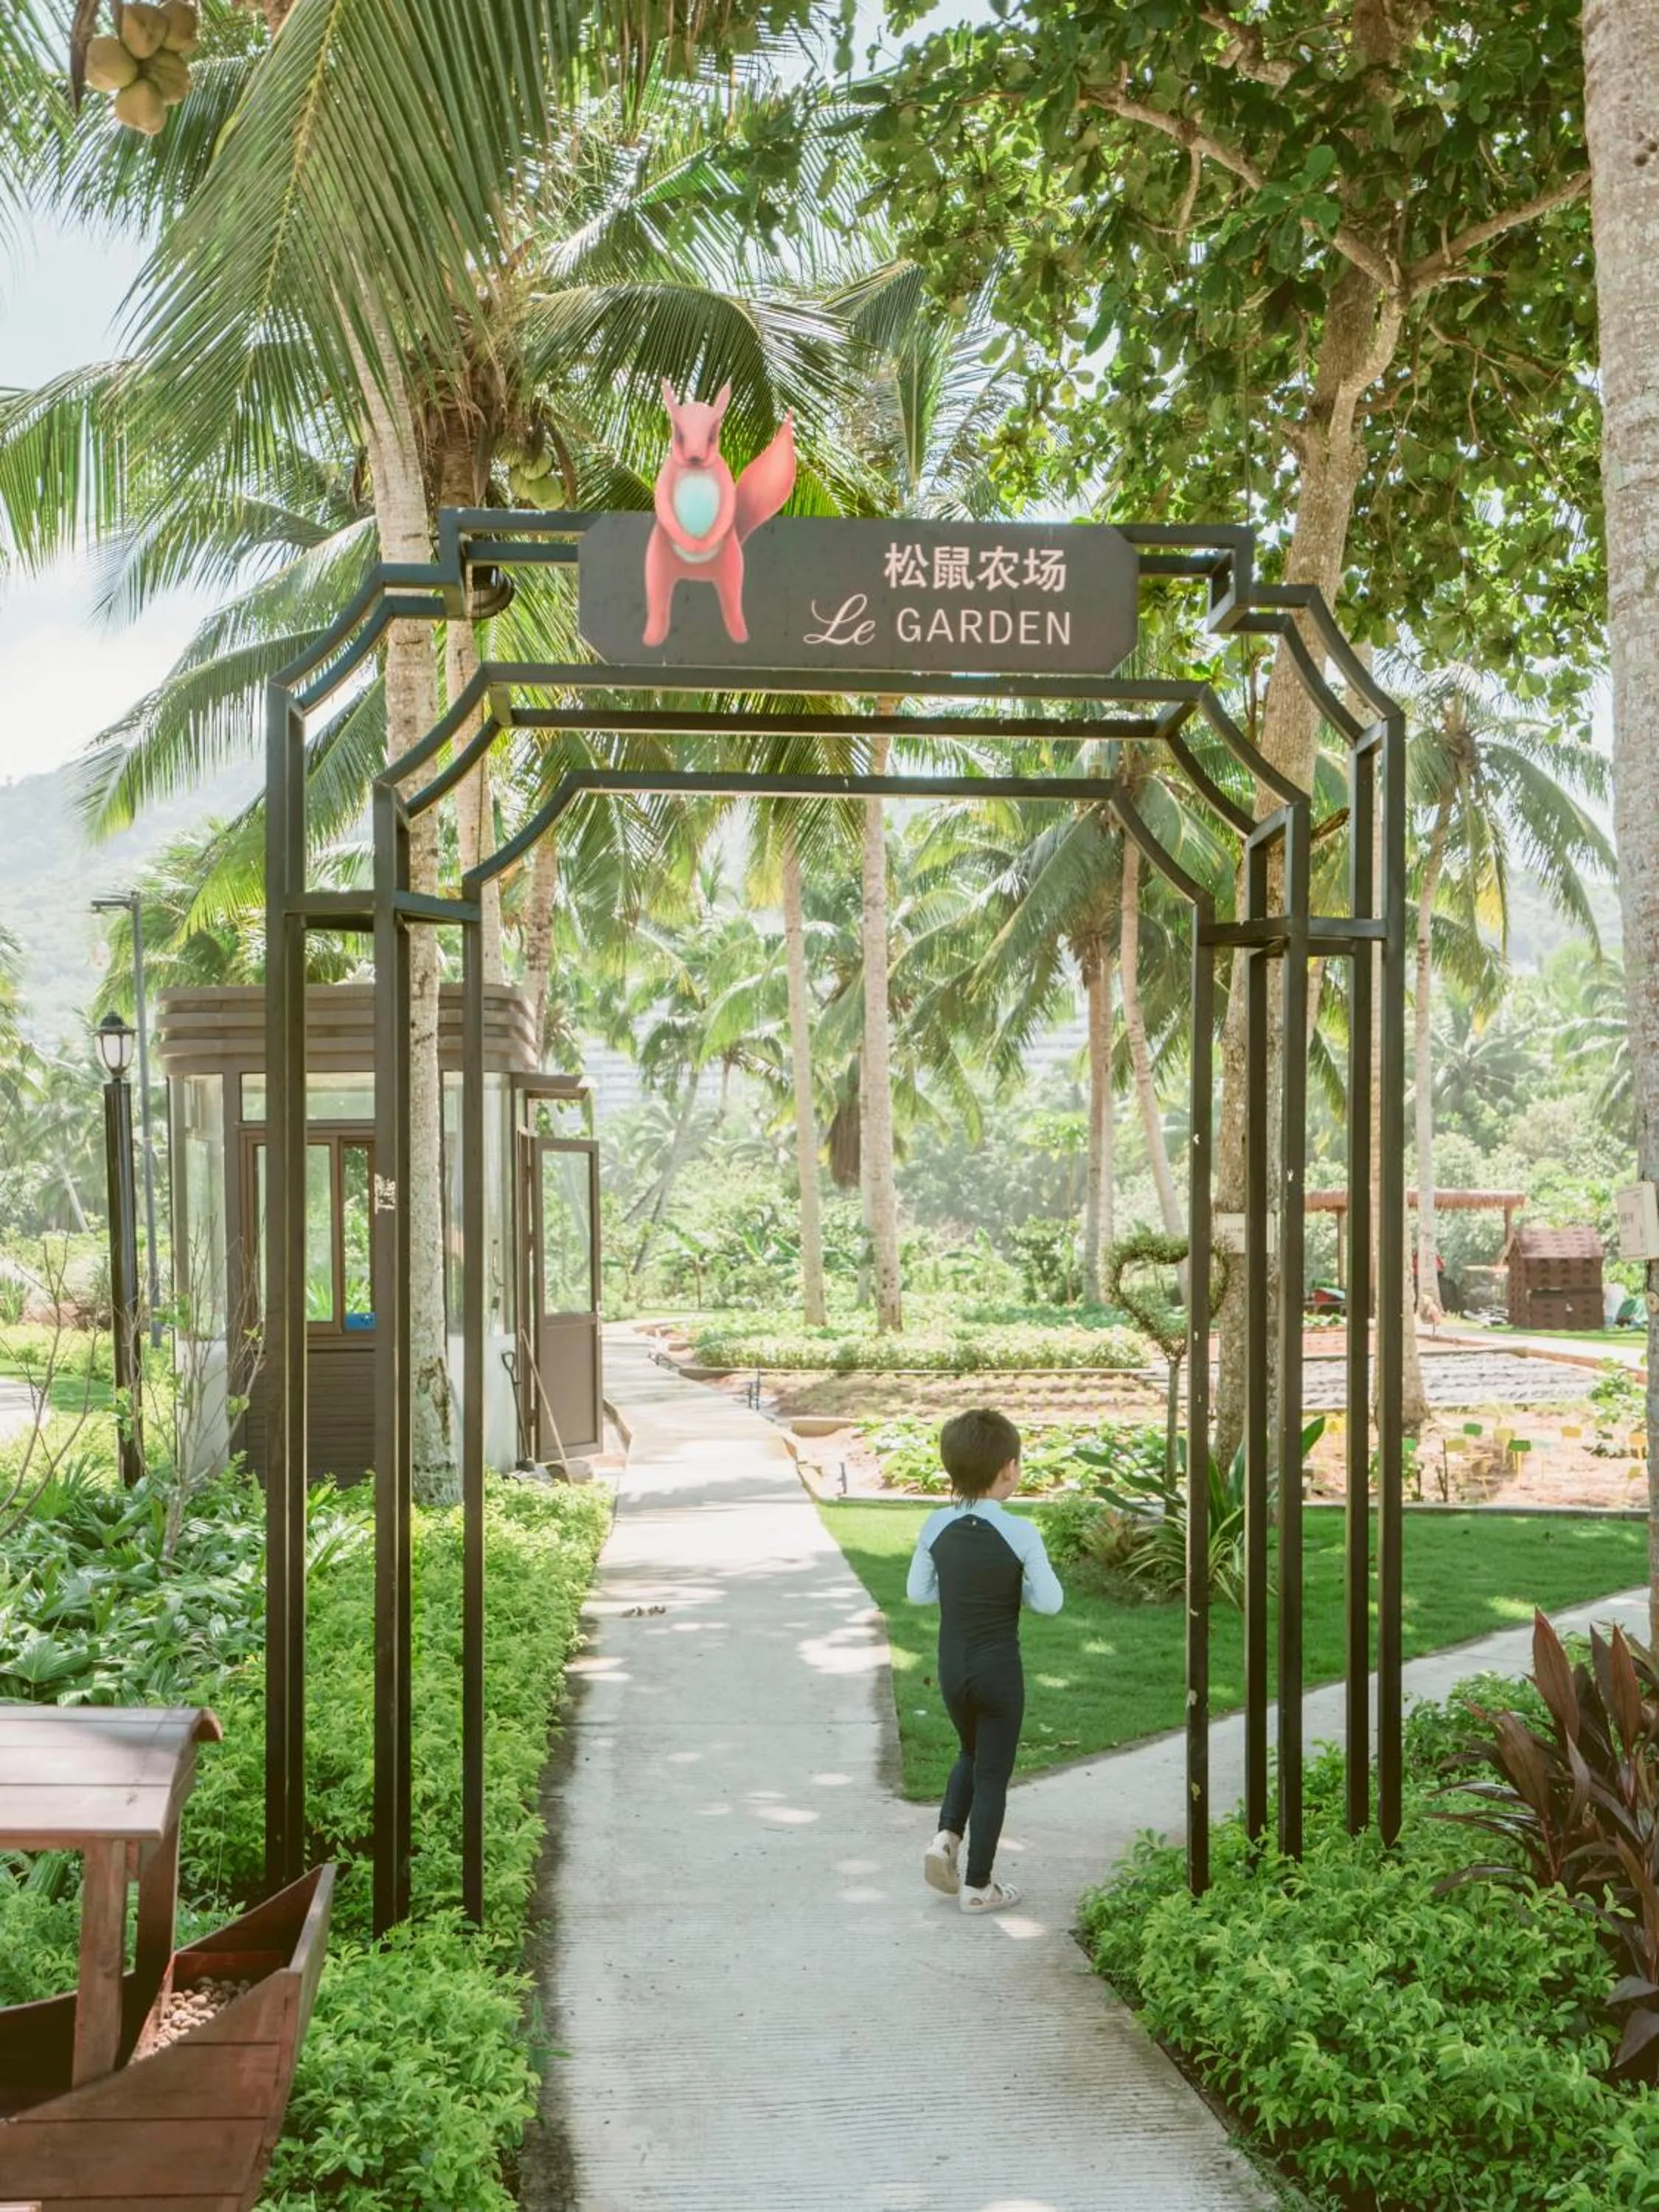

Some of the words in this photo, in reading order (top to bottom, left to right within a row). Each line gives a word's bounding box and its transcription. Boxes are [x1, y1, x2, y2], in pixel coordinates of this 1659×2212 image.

[884, 542, 1068, 593] 松鼠农场
[803, 593, 876, 646] Le
[896, 607, 1071, 646] GARDEN
